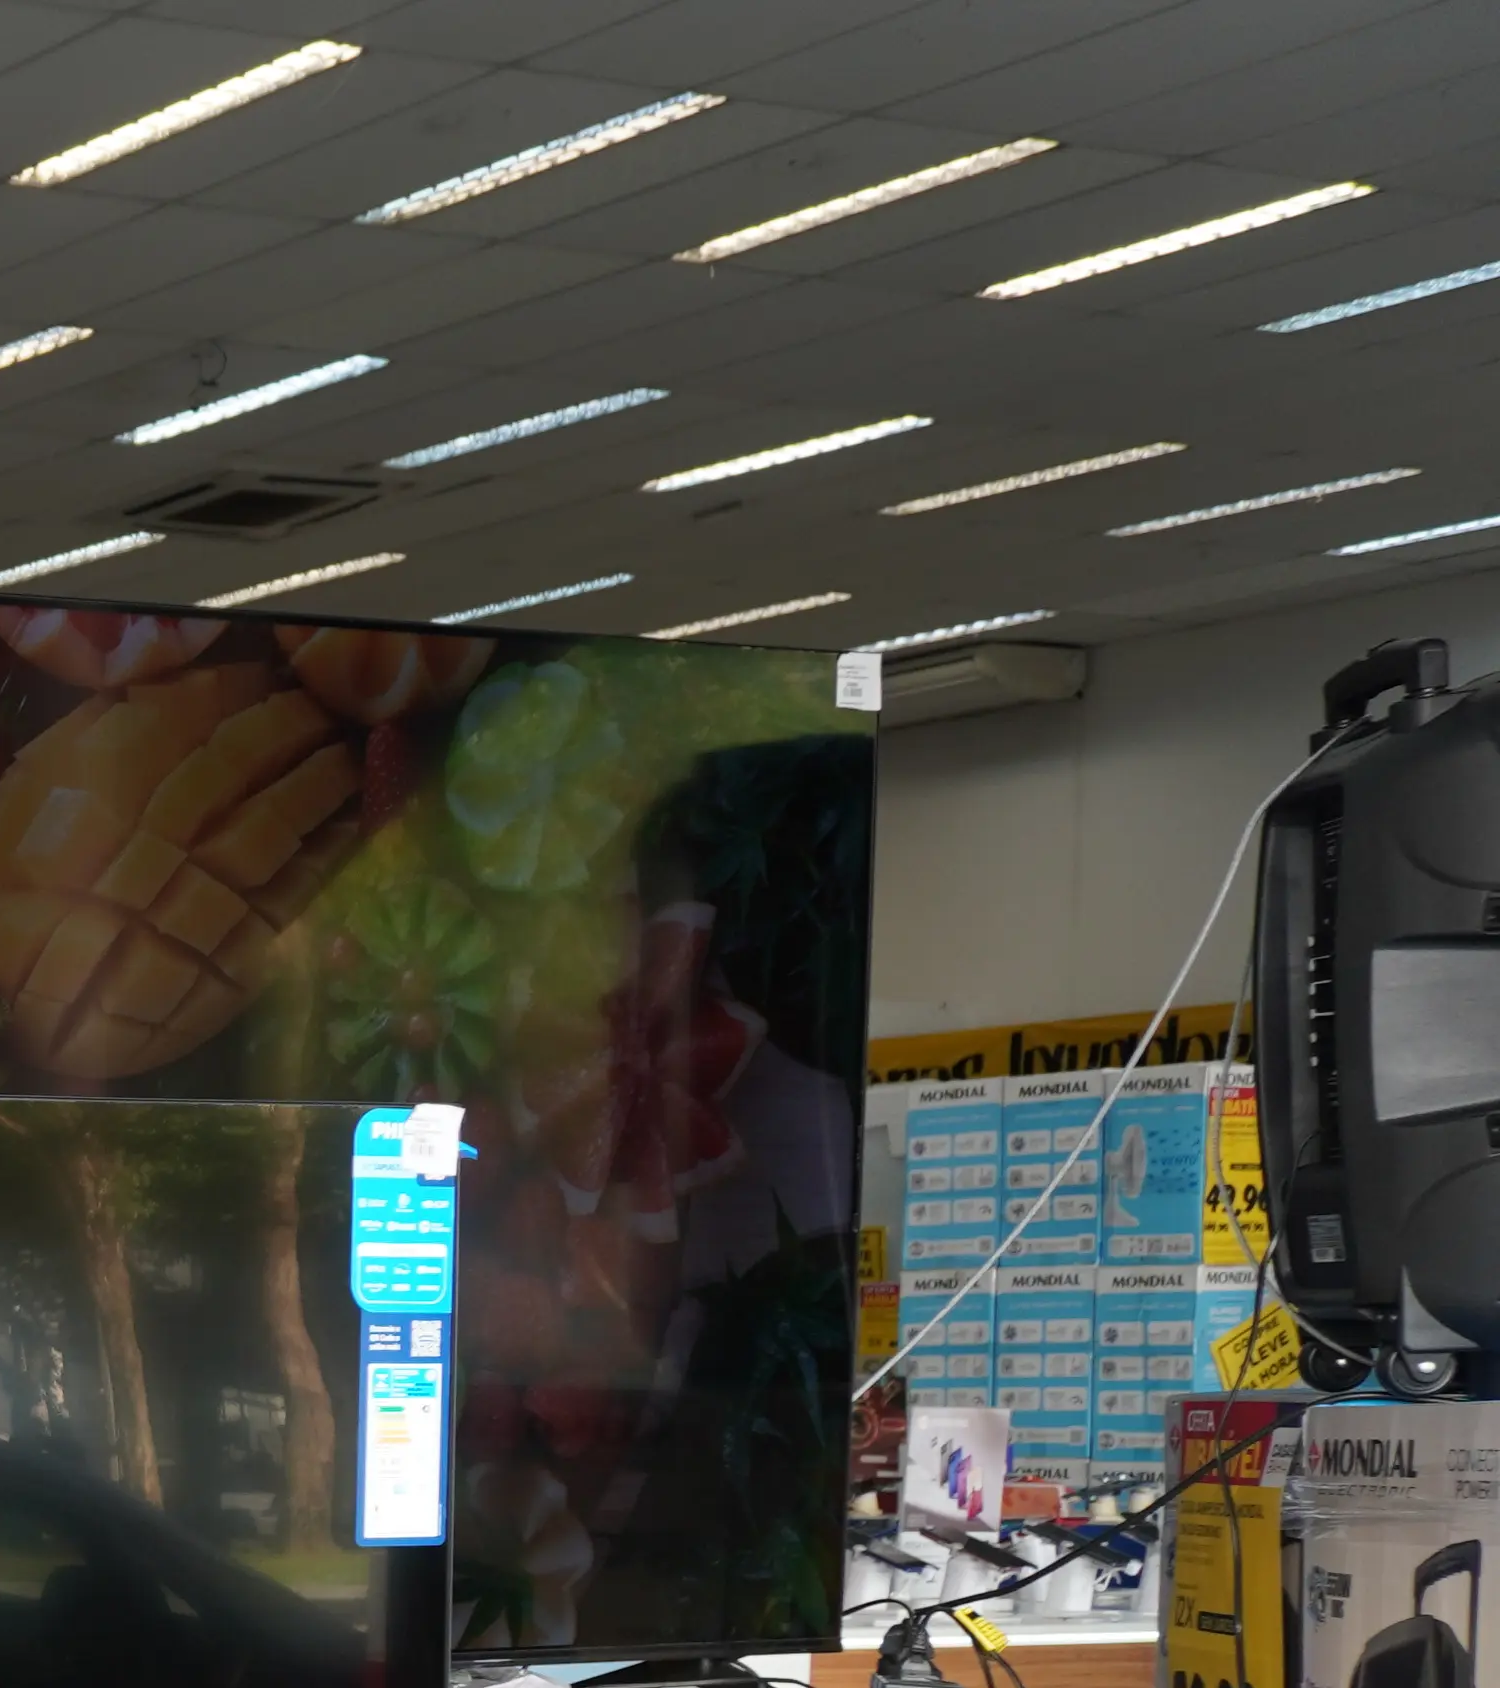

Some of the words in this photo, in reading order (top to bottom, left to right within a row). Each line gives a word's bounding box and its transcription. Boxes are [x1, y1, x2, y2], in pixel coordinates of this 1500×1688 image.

[1018, 1080, 1089, 1098] MONDIAL
[1010, 1273, 1080, 1290] MONDIAL
[1111, 1273, 1184, 1290] MONDIAL
[1321, 1437, 1417, 1479] MONDIAL
